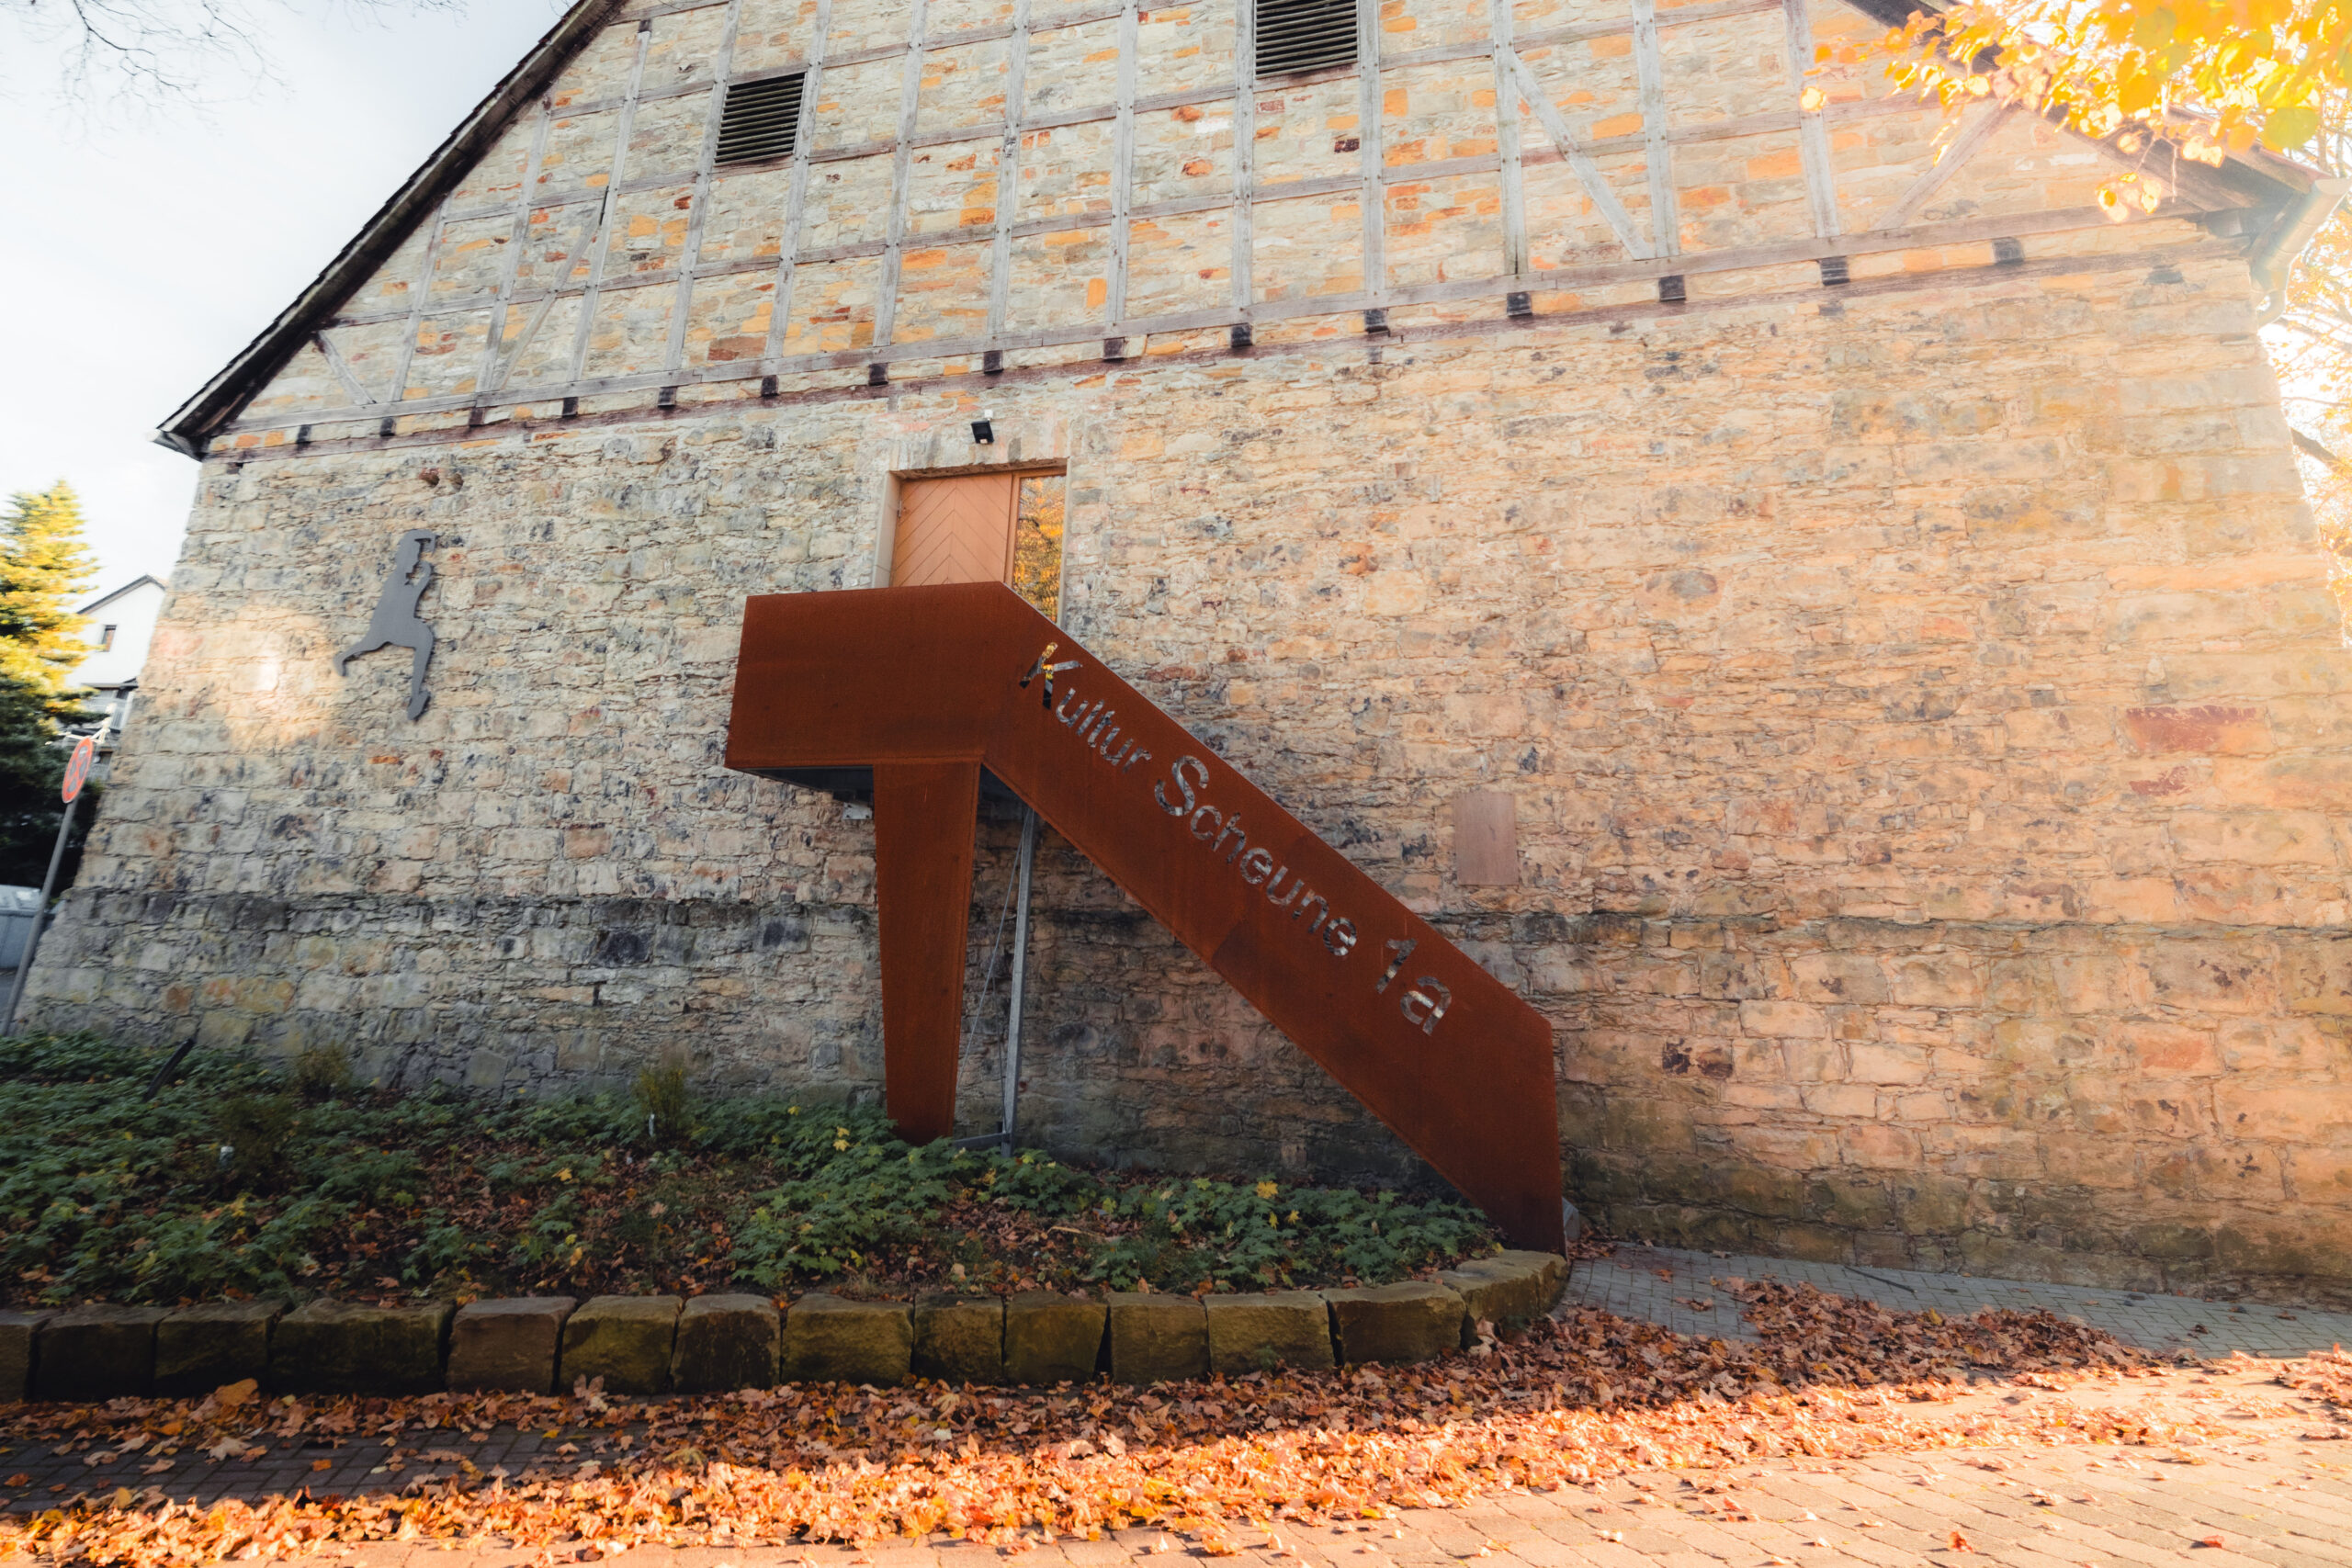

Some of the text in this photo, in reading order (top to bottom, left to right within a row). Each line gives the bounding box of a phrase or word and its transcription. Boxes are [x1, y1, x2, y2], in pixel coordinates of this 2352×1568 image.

[1019, 642, 1453, 1035] Kultur Scheune 1a
